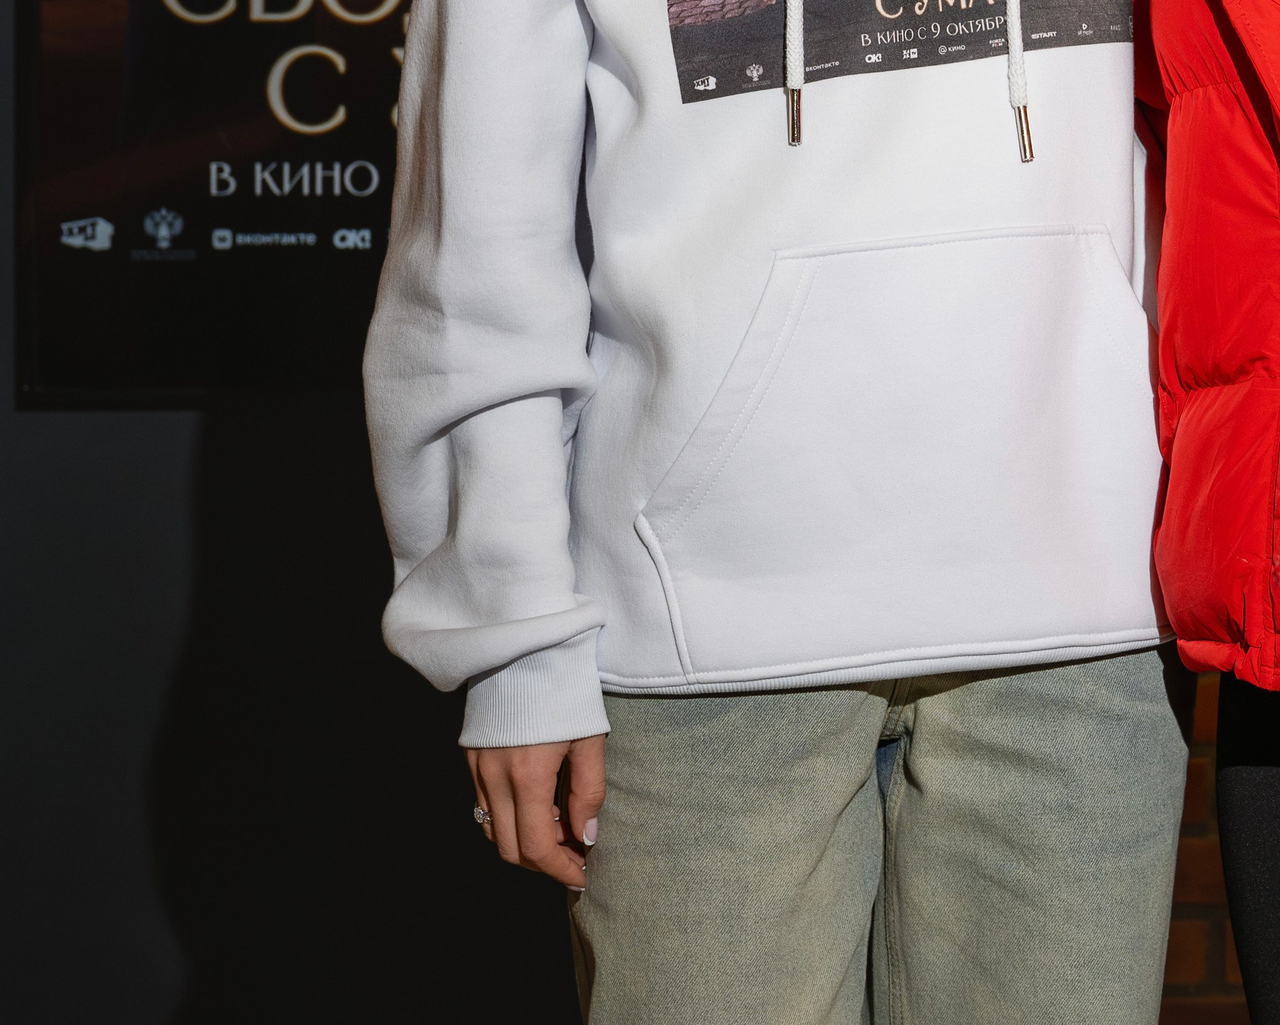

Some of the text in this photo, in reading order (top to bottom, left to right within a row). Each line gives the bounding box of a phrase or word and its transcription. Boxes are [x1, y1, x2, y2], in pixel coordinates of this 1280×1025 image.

[861, 15, 1007, 47] В КИНО С 9 ОКТЯБР
[267, 44, 346, 134] С
[209, 160, 380, 197] В КИНО
